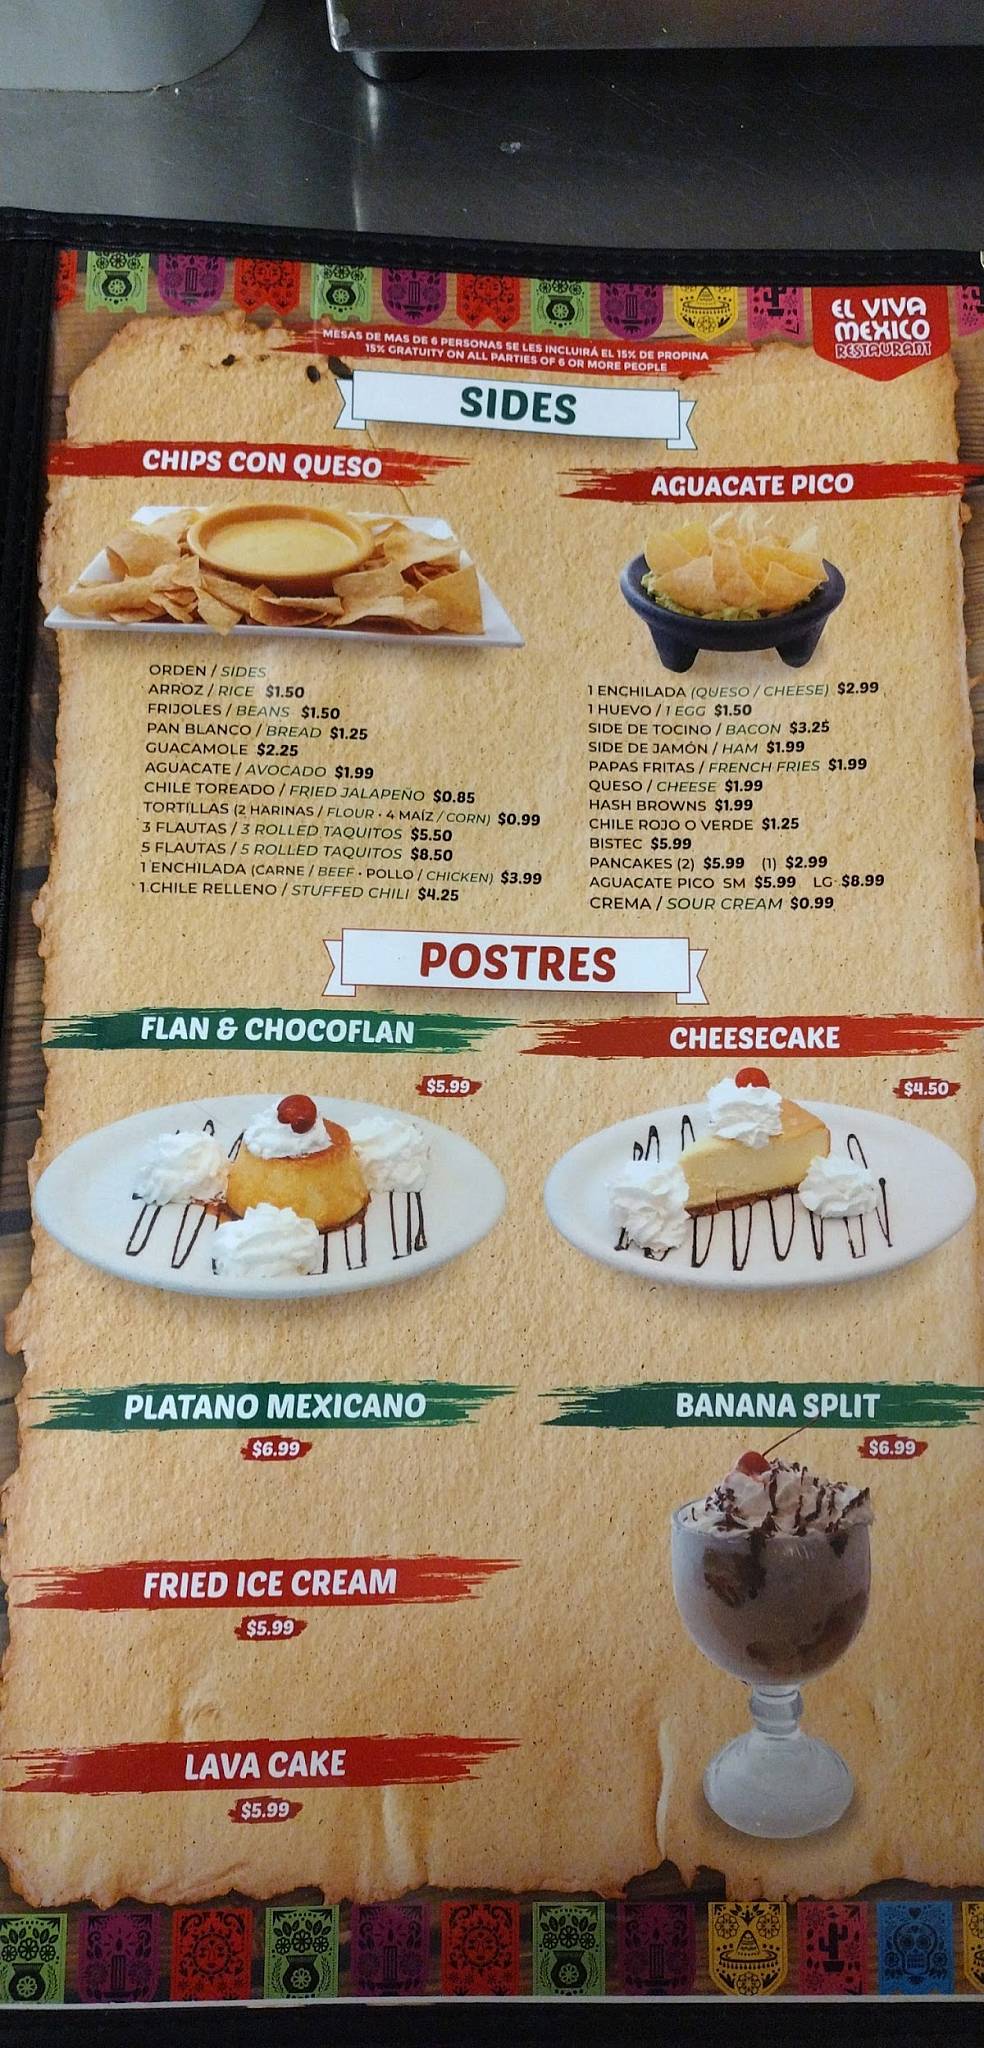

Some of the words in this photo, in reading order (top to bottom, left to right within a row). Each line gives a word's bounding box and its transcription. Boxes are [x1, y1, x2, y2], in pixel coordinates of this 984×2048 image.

[832, 299, 855, 319] EL
[862, 297, 927, 319] VIVA
[834, 319, 930, 342] MEXICO
[323, 330, 362, 340] MESAS
[366, 332, 381, 341] DE
[384, 335, 409, 343] MAS
[413, 336, 427, 345] DE
[431, 337, 437, 345] 6
[441, 338, 502, 349] PERSONAS
[506, 343, 519, 351] SE
[523, 343, 542, 353] LES
[546, 345, 598, 357] INCLUIRÁ
[602, 349, 614, 357] EL
[617, 349, 636, 358] 15%
[640, 350, 654, 359] DE
[658, 351, 709, 360] PROPINA
[835, 341, 931, 359] RESTAURANT
[365, 344, 384, 354] 15%
[388, 346, 444, 357] GRATUITY
[447, 350, 464, 359] ON
[467, 352, 487, 360] ALL
[491, 354, 537, 364] PARTIES
[541, 356, 556, 365] OF
[559, 358, 565, 367] 6
[568, 358, 584, 367] OR
[588, 360, 621, 370] MORE
[624, 362, 667, 372] PEOPLE
[460, 386, 577, 425] SIDES
[143, 448, 222, 472] CHIPS
[228, 451, 286, 474] CON
[293, 453, 382, 480] QUESO
[651, 475, 784, 496] AGUACATE
[791, 473, 854, 494] PICO
[149, 664, 207, 677] ORDEN
[220, 666, 267, 678] SIDES
[148, 684, 204, 697] ARROZ
[218, 685, 254, 697] RICE
[265, 685, 305, 699] $1.50
[598, 685, 687, 698] ENCHILADA
[691, 686, 749, 700] (QUESO
[763, 684, 830, 698] CHEESE)
[837, 681, 879, 695] $2.99
[148, 703, 222, 717] FRIJOLES
[236, 705, 291, 718] BEANS
[301, 706, 341, 721] $1.50
[598, 704, 651, 716] HUEVO
[675, 704, 706, 717] EGG
[714, 704, 752, 717] $1.50
[147, 722, 181, 735] PAN
[185, 724, 252, 737] BLANCO
[266, 726, 322, 739] BREAD
[329, 726, 368, 741] $1.25
[588, 723, 623, 734] SIDE
[628, 724, 648, 735] DE
[652, 724, 712, 736] TOCINO
[726, 723, 781, 735] BACON
[789, 720, 830, 734] $3.25
[145, 741, 249, 756] GUACAMOLE
[256, 742, 299, 758] $2.25
[588, 741, 623, 753] SIDE
[628, 742, 648, 754] DE
[651, 740, 708, 755] JAMÓN
[722, 743, 759, 754] HAM
[766, 740, 805, 754] $1.99
[145, 762, 232, 776] AGUACATE
[244, 765, 328, 779] AVOCADO
[335, 766, 374, 781] $1.99
[589, 761, 639, 773] PAPAS
[643, 761, 695, 773] FRITAS
[708, 761, 772, 773] FRENCH
[777, 760, 820, 772] FRIES
[828, 758, 867, 771] $1.99
[143, 782, 192, 794] CHILE
[195, 783, 275, 796] TOREADO
[289, 785, 338, 799] FRIED
[340, 785, 426, 802] JALAPEÑO
[432, 790, 475, 805] $0.85
[588, 780, 643, 794] QUESO
[656, 781, 717, 793] CHEESE
[724, 779, 763, 792] $1.99
[143, 801, 229, 815] TORTILLAS
[233, 804, 248, 818] (2
[250, 805, 315, 817] HARINAS
[326, 807, 375, 819] FLOUR
[386, 809, 396, 820] 4
[398, 806, 435, 823] MAÍZ
[446, 812, 492, 826] CORN)
[497, 812, 541, 827] $0.99
[589, 799, 632, 811] HASH
[636, 800, 707, 812] BROWNS
[714, 798, 753, 812] $1.99
[142, 821, 152, 834] 3
[156, 822, 227, 836] FLAUTAS
[240, 825, 251, 836] 3
[254, 823, 319, 838] ROLLED
[324, 825, 403, 841] TAQUITOS
[411, 827, 453, 843] $5.50
[589, 818, 634, 831] CHILE
[638, 819, 682, 832] ROJO
[685, 819, 697, 832] O
[701, 819, 753, 831] VERDE
[761, 817, 800, 831] $1.25
[141, 841, 151, 854] 5
[155, 842, 227, 856] FLAUTAS
[240, 844, 250, 856] 5
[254, 844, 319, 857] ROLLED
[324, 846, 403, 861] TAQUITOS
[411, 847, 453, 862] $8.50
[589, 838, 643, 850] BISTEC
[650, 837, 692, 850] $5.99
[589, 857, 673, 870] PANCAKES
[677, 857, 695, 872] (2)
[703, 856, 745, 870] $5.99
[761, 857, 777, 871] (1)
[785, 855, 828, 869] $2.99
[151, 862, 247, 876] ENCHILADA
[251, 864, 306, 878] (CARNE
[317, 866, 355, 878] BEEF
[366, 867, 414, 881] POLLO
[426, 869, 494, 884] CHICKEN)
[500, 870, 542, 885] $3.99
[589, 876, 673, 889] AGUACATE
[677, 877, 715, 889] PICO
[723, 877, 746, 889] SM
[754, 875, 797, 889] $5.99
[812, 876, 834, 888] LG
[841, 874, 885, 888] $8.99
[151, 882, 200, 895] CHILE
[203, 882, 277, 896] RELLENO
[291, 884, 365, 898] STUFFED
[368, 886, 411, 899] CHILI
[417, 887, 460, 902] $4.25
[589, 897, 652, 910] CREMA
[666, 897, 716, 910] SOUR
[720, 898, 783, 910] CREAM
[790, 896, 834, 910] $0.99
[419, 940, 617, 984] POSTRES
[141, 1016, 210, 1041] FLAN
[216, 1017, 238, 1041] &
[244, 1017, 415, 1045] CHOCOFLAN
[669, 1025, 841, 1051] CHEESECAKE
[426, 1078, 471, 1095] $5.99
[903, 1079, 949, 1097] $4.50
[124, 1393, 260, 1420] PLATANO
[266, 1392, 427, 1419] MEXICANO
[676, 1392, 797, 1419] BANANA
[803, 1392, 881, 1419] SPLIT
[251, 1440, 300, 1457] $6.99
[868, 1439, 916, 1456] $6.99
[143, 1571, 229, 1599] FRIED
[236, 1570, 284, 1598] ICE
[290, 1568, 397, 1596] CREAM
[246, 1620, 295, 1637] $5.99
[185, 1752, 262, 1781] LAVA
[268, 1749, 347, 1778] CAKE
[240, 1802, 290, 1820] $5.99
